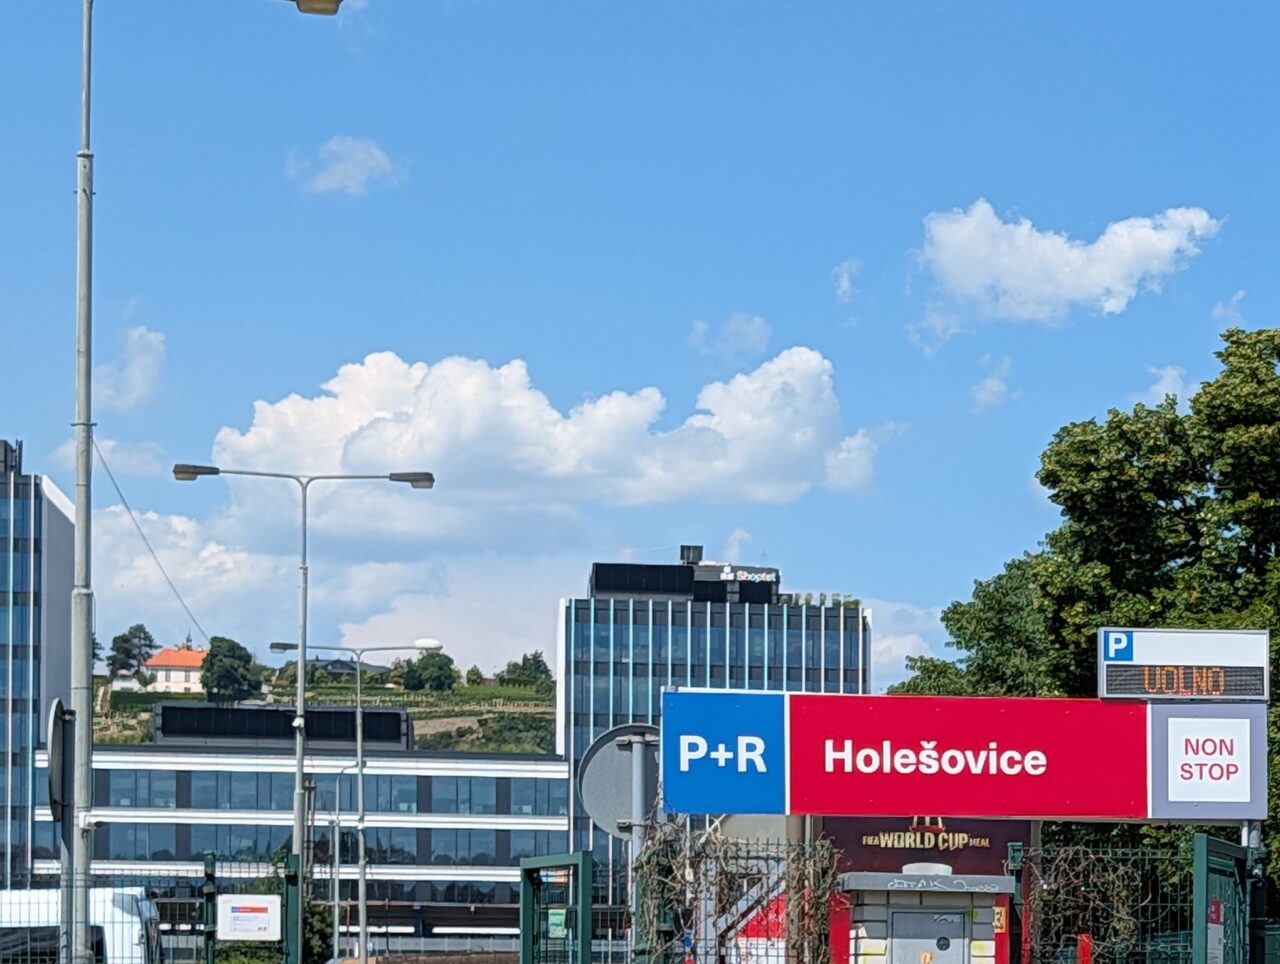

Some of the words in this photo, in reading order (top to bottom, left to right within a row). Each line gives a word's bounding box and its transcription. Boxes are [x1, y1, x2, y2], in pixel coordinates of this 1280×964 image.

[1108, 632, 1128, 658] P
[679, 735, 767, 773] P+R
[824, 740, 1048, 775] Holešovice
[1184, 738, 1234, 756] NON
[1180, 763, 1239, 781] STOP
[880, 831, 935, 849] WORLD
[937, 832, 968, 851] CUP
